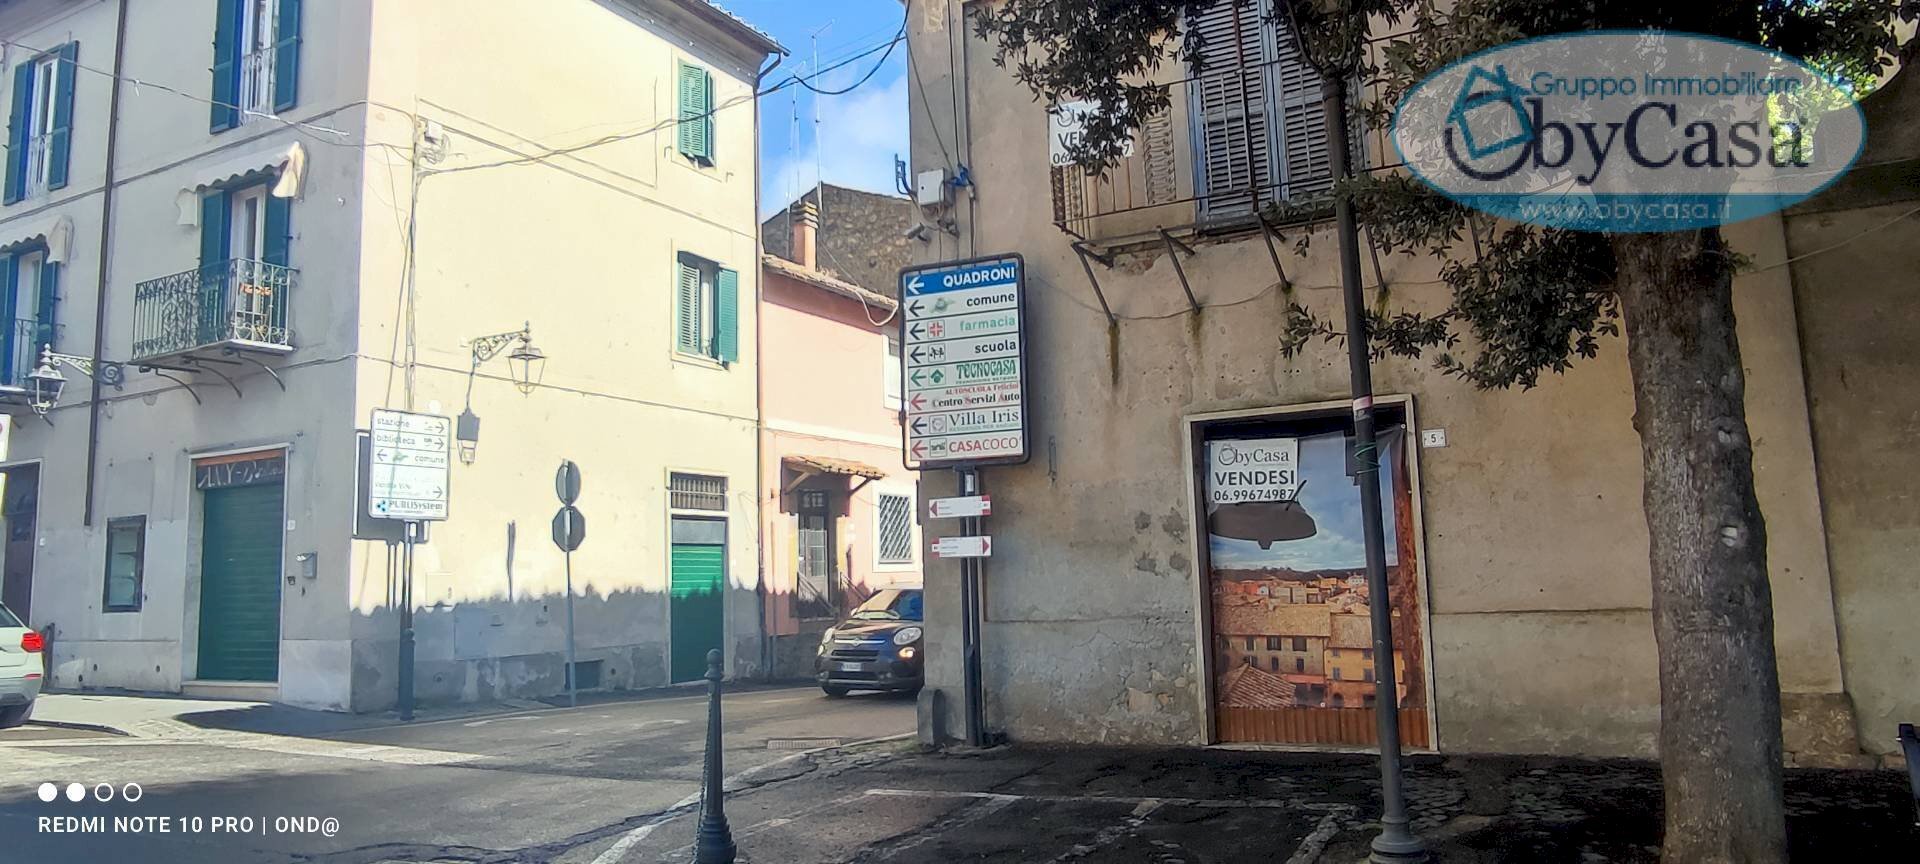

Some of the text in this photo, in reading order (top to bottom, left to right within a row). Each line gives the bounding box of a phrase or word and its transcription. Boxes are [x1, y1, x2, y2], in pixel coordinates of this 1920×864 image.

[943, 267, 1015, 287] QUADRONI
[966, 293, 1015, 307] comune
[960, 315, 1016, 331] farmacia
[975, 340, 1016, 354] scuola
[956, 360, 1017, 379] TECNOCASA
[932, 398, 963, 408] Centro
[998, 393, 1020, 402] Auto
[949, 411, 985, 427] Villa
[992, 409, 1019, 422] Iris
[1430, 433, 1437, 443] 5
[414, 455, 444, 464] comune
[1218, 446, 1290, 467] ObyCasa
[1214, 469, 1295, 486] VENDESI
[1214, 488, 1295, 501] 06.99674987
